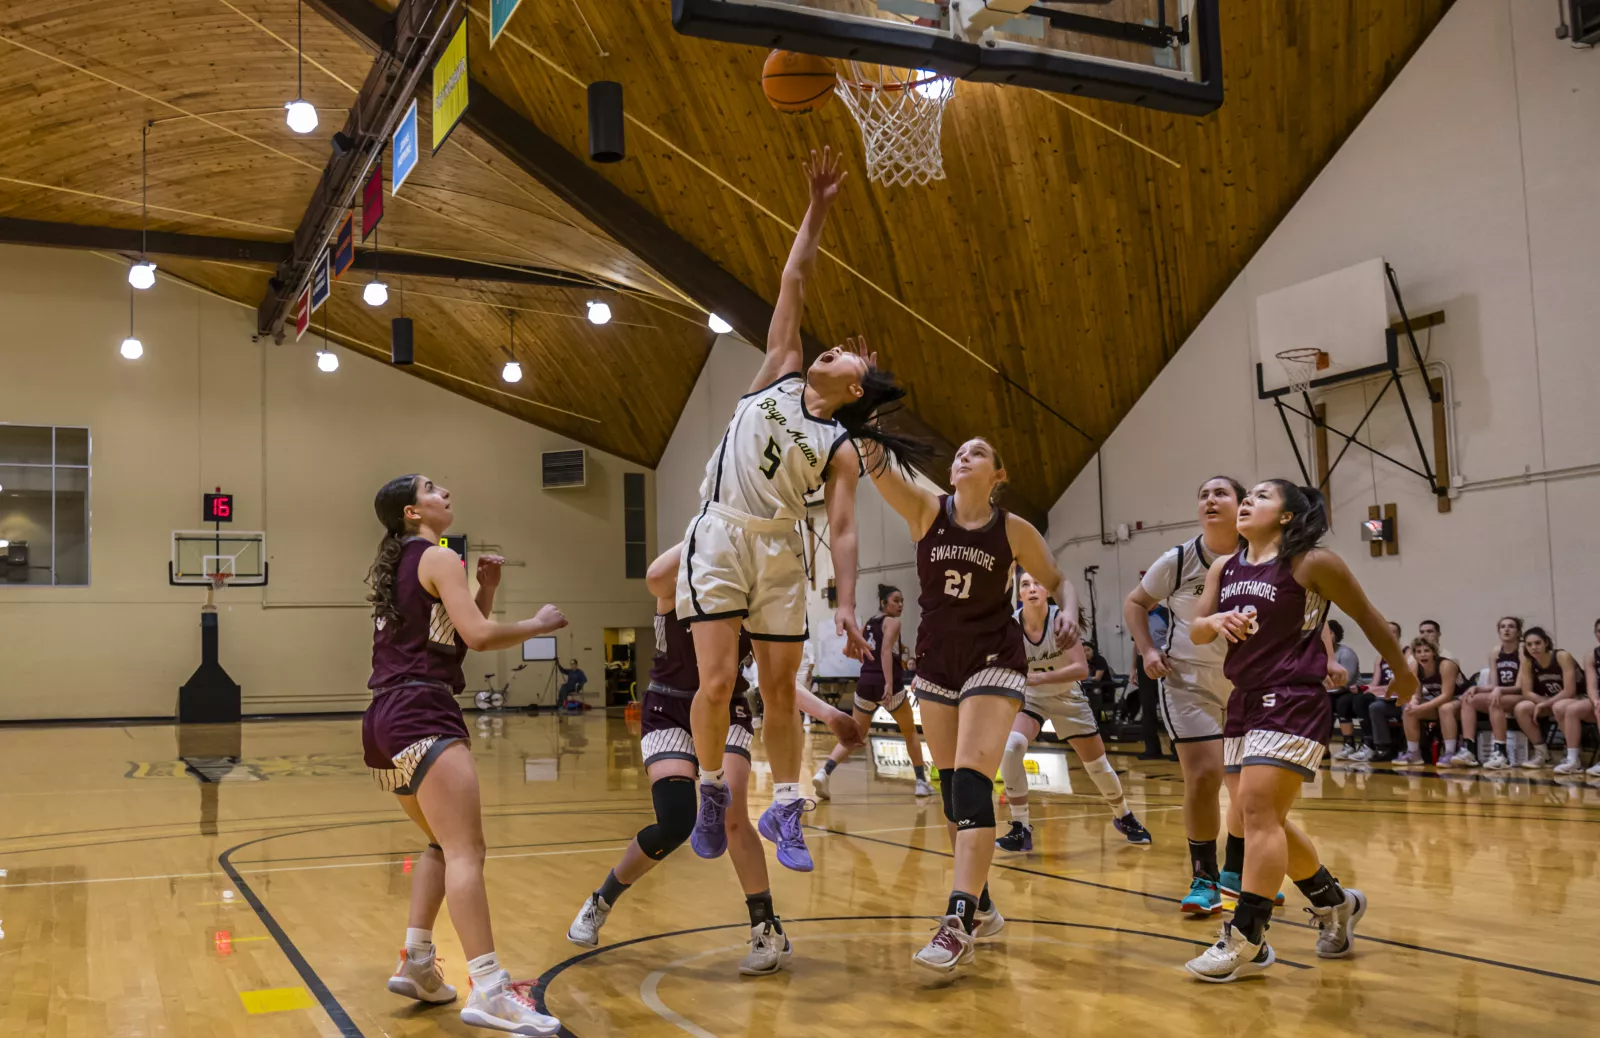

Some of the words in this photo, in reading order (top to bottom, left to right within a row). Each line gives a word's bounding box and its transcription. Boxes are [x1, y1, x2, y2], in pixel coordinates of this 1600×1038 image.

[757, 398, 787, 426] Bryn
[786, 429, 818, 468] Mawr
[759, 435, 781, 480] 5
[213, 497, 230, 517] 16
[930, 545, 996, 572] SWARTHMORE
[944, 569, 973, 599] 21
[1220, 580, 1278, 603] SWARTHMORE
[1500, 670, 1514, 684] 22
[1262, 692, 1277, 708] S
[735, 705, 747, 719] S
